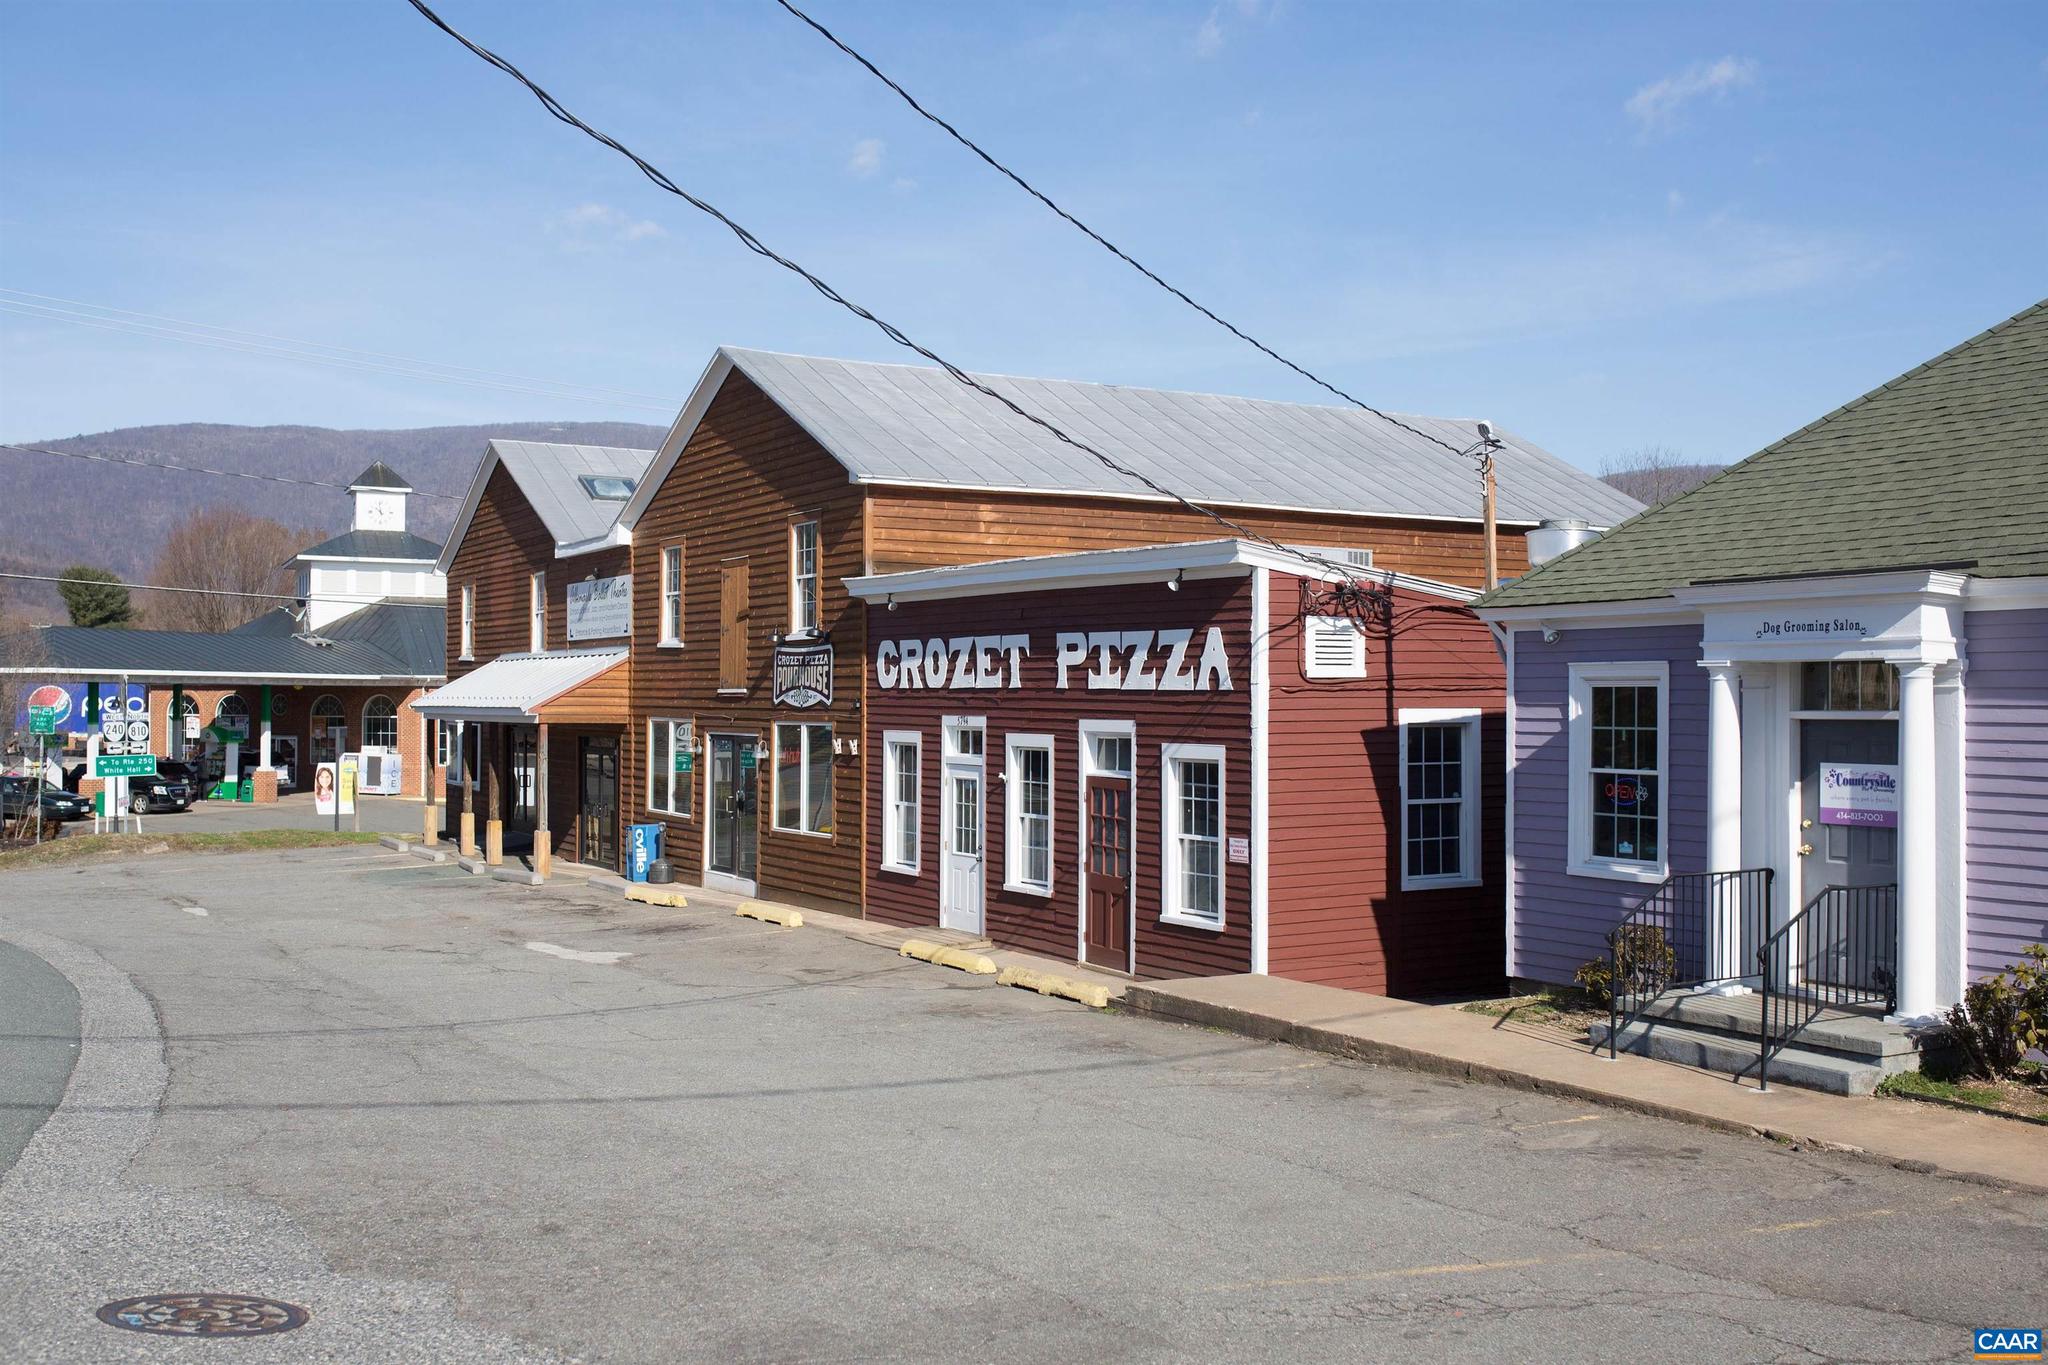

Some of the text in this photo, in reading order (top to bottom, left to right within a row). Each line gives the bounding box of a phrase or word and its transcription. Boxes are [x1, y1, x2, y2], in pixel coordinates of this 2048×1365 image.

[1763, 619, 1861, 635] Dog Grooming Salon
[777, 653, 829, 665] CROZET PIZZA
[876, 626, 1234, 691] CROZET PIZZA
[776, 665, 829, 696] POURHOUSE
[105, 724, 124, 735] 240
[130, 725, 147, 737] 810
[1836, 772, 1896, 789] Countryside
[1605, 783, 1636, 799] OPEN
[1836, 811, 1884, 822] 434-823-7002
[635, 828, 647, 873] cville
